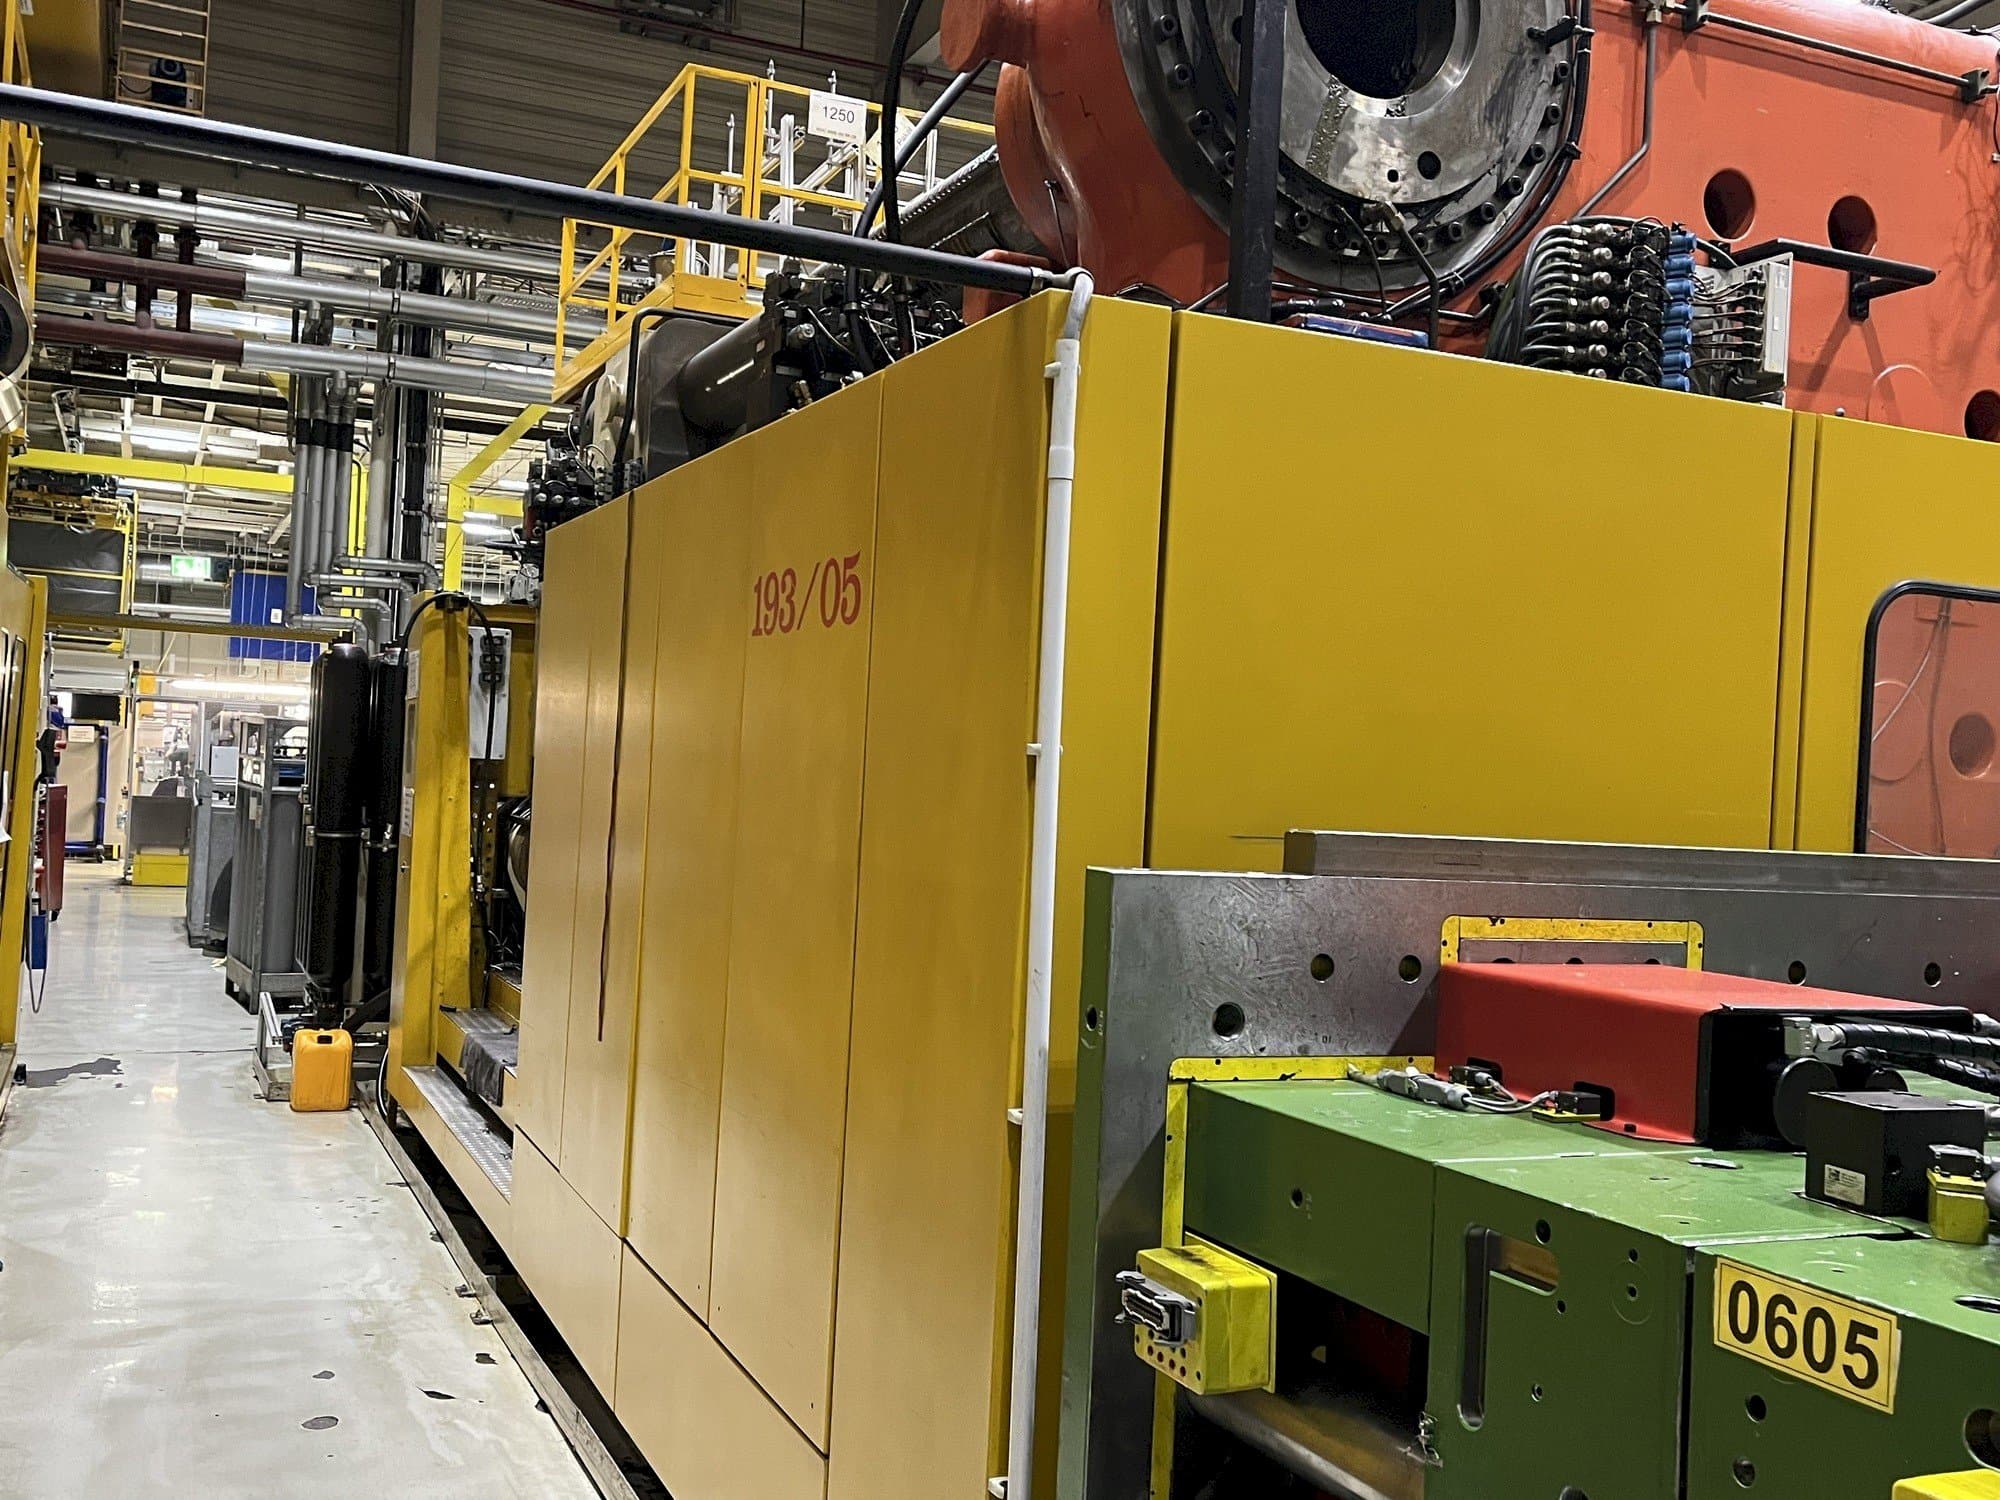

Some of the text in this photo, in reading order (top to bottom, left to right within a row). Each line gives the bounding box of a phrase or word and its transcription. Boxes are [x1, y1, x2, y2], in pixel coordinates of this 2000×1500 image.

[823, 105, 855, 124] 1250
[751, 549, 862, 637] 193/05
[1728, 1279, 1880, 1390] 0605
